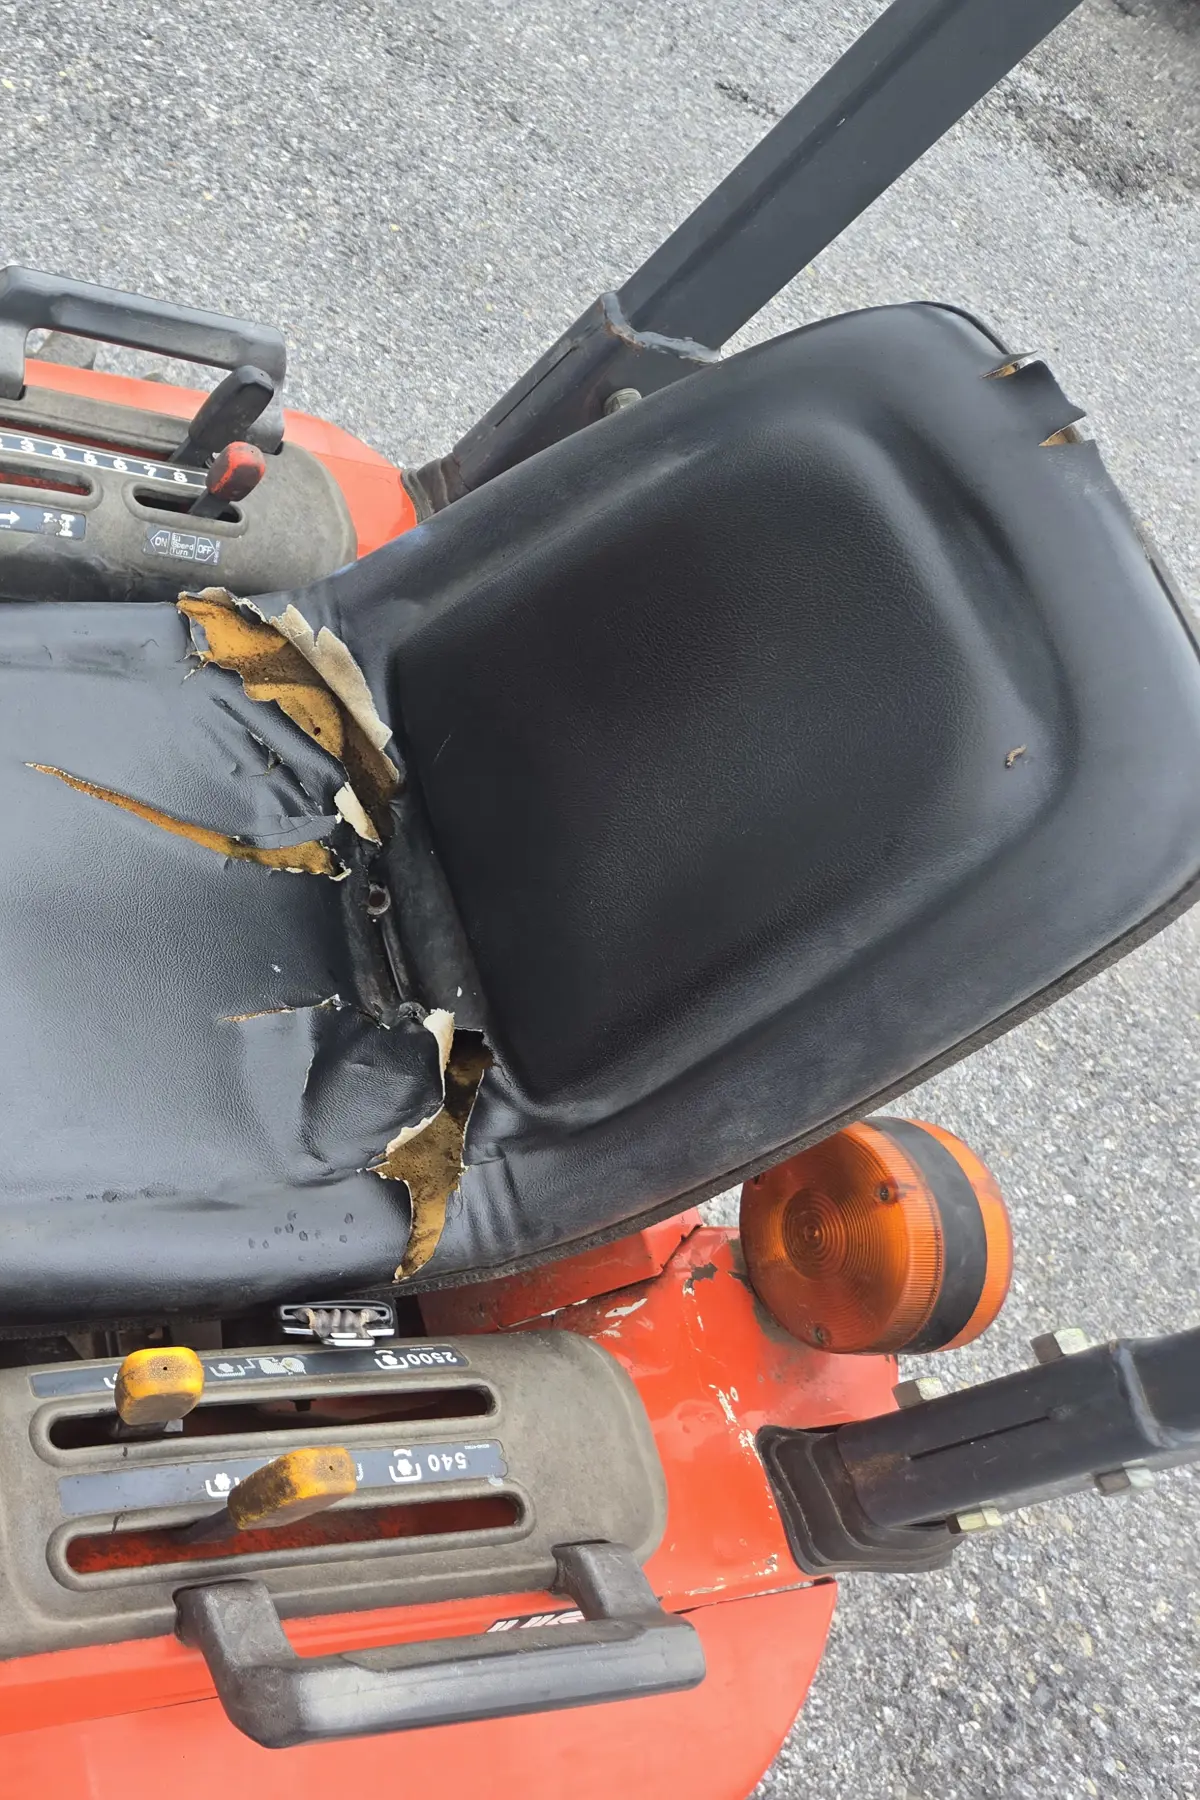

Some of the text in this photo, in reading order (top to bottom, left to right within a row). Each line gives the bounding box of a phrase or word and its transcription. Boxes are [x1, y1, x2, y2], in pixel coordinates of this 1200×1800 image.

[84, 452, 97, 466] 5
[113, 459, 128, 472] 6
[143, 464, 157, 477] 7
[173, 470, 188, 483] 8
[154, 536, 168, 547] ON
[171, 540, 194, 551] Speed
[171, 547, 188, 556] Turn
[198, 544, 212, 555] OFF
[406, 1351, 458, 1365] 2500
[427, 1452, 467, 1472] 540
